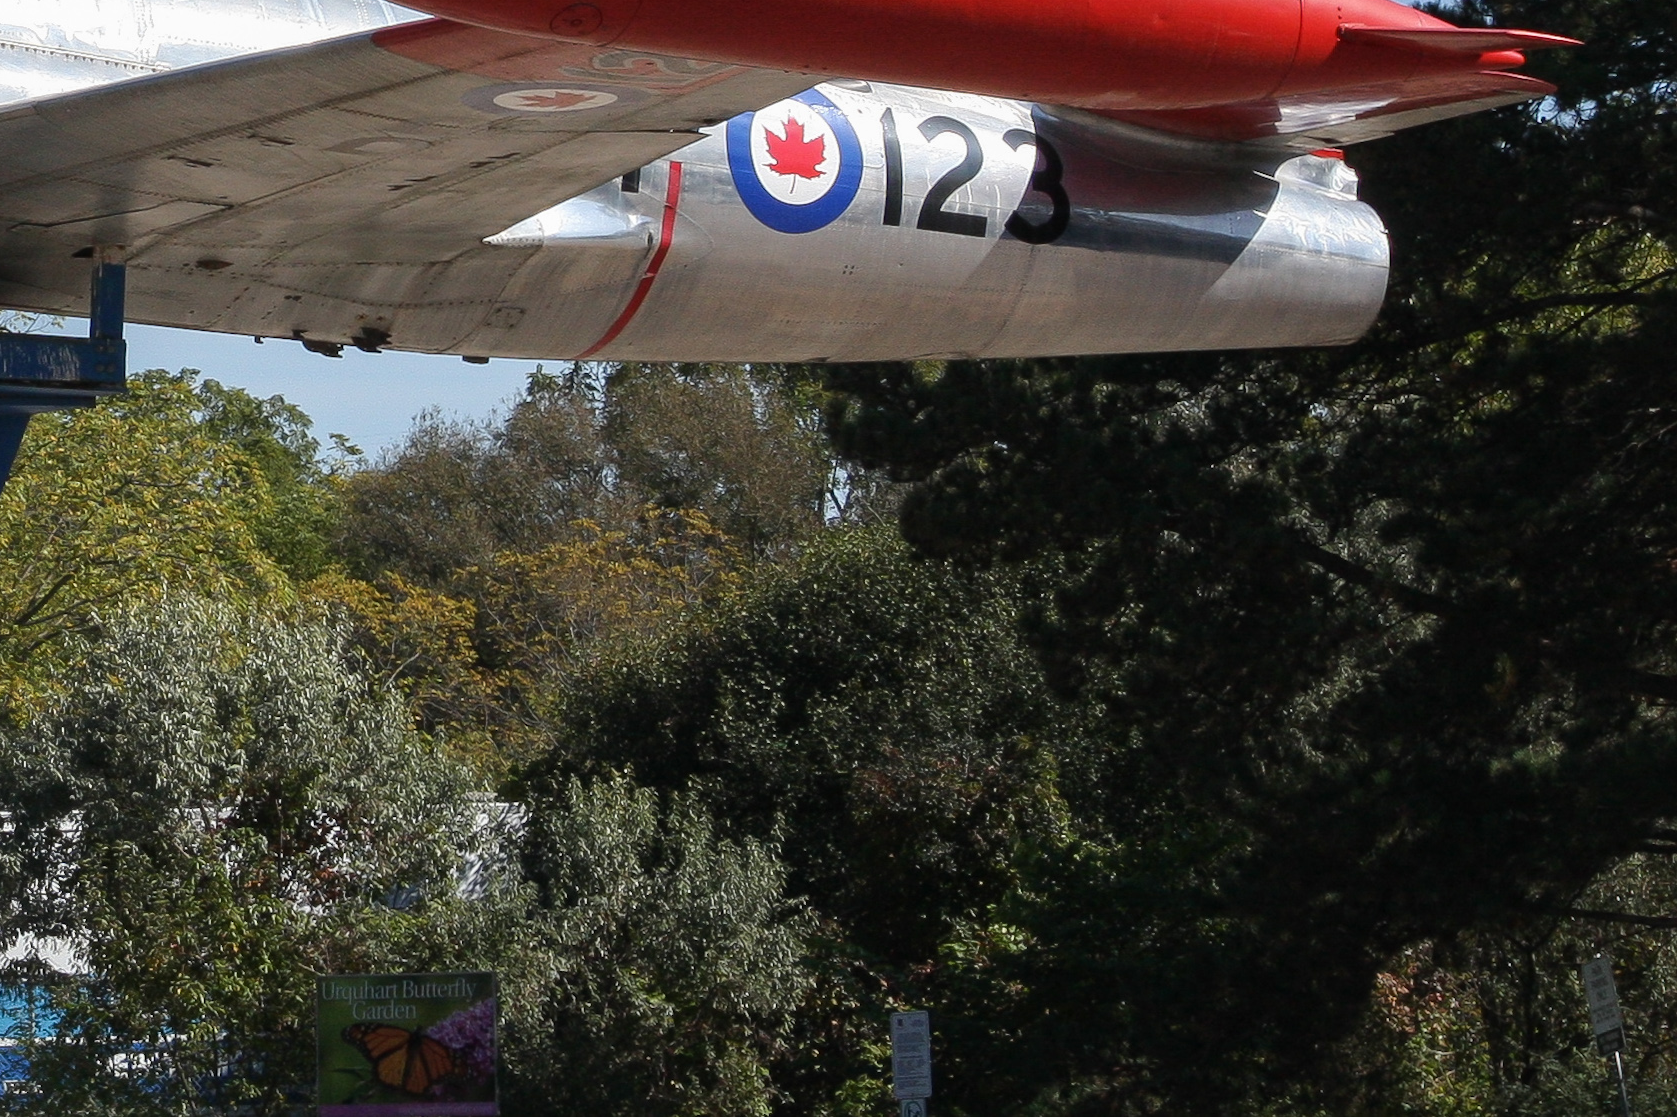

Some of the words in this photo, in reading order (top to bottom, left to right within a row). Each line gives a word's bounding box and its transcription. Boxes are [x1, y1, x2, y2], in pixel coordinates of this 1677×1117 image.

[881, 106, 1072, 245] 123
[322, 981, 397, 1005] Urquhart
[402, 977, 478, 1002] Butterfly
[352, 999, 417, 1021] Garden
